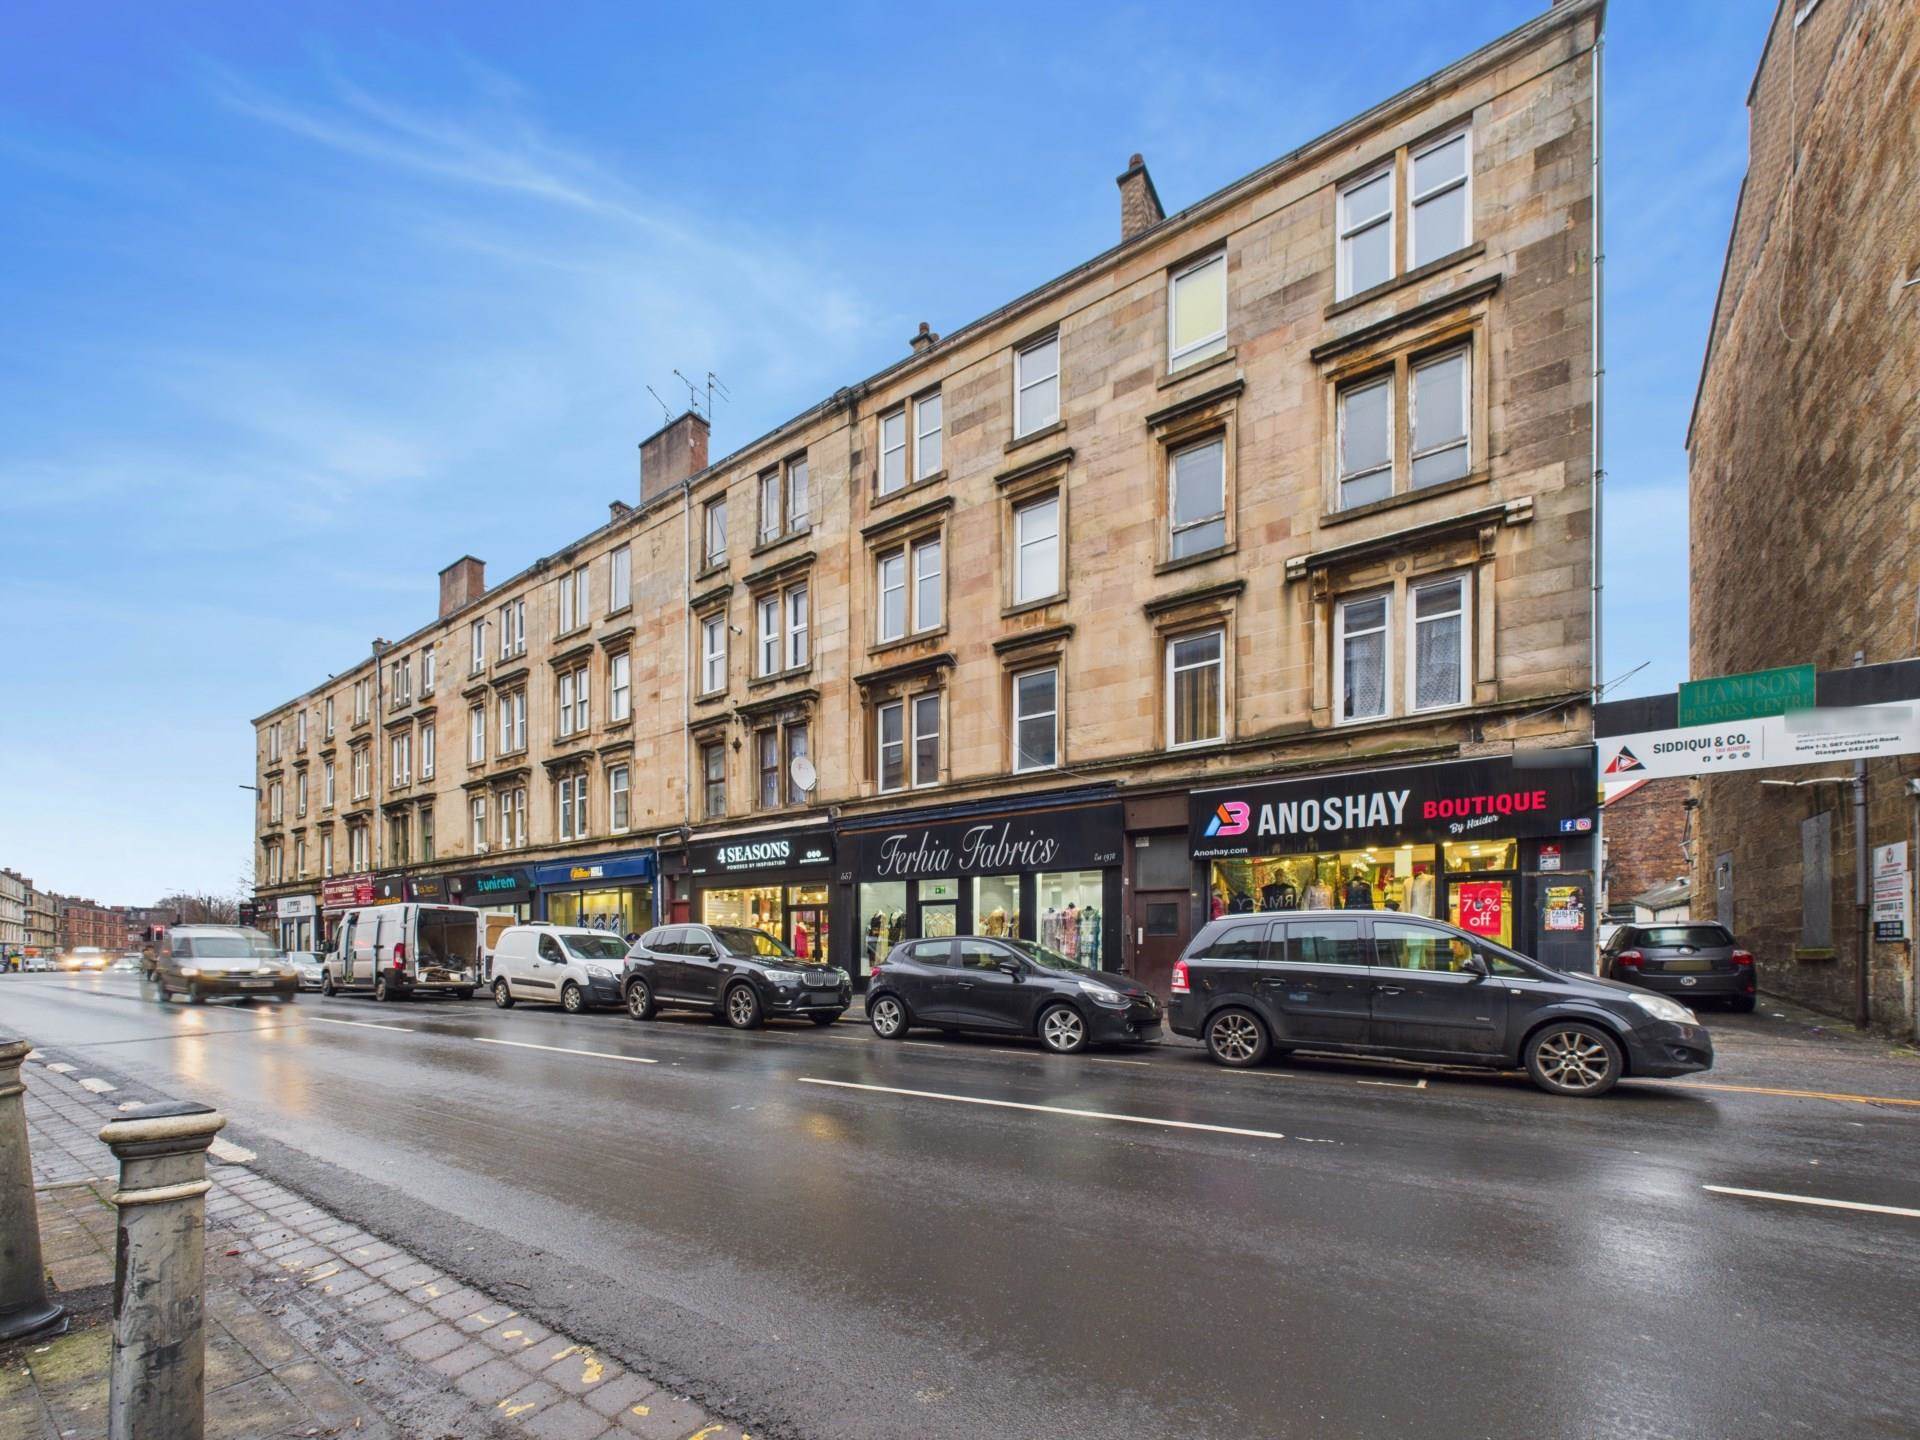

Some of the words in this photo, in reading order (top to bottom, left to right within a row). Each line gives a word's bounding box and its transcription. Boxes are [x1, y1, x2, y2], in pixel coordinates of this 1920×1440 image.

[1695, 671, 1801, 705] HANISON
[1684, 701, 1747, 722] BUSINESS
[1653, 738, 1711, 754] SIDDIQUI
[1714, 736, 1724, 747] &
[1726, 733, 1751, 746] CO.
[1257, 790, 1411, 837] ANOSHAY
[1423, 790, 1547, 820] BOUTIQUE
[1449, 822, 1464, 834] By
[1466, 814, 1500, 831] Haider
[717, 847, 726, 864] 4
[726, 840, 790, 863] SEASONS
[877, 831, 953, 876] Ferhia
[958, 822, 1060, 870] Fabrics
[1193, 846, 1248, 858] Anoshay.com
[1469, 911, 1492, 927] off
